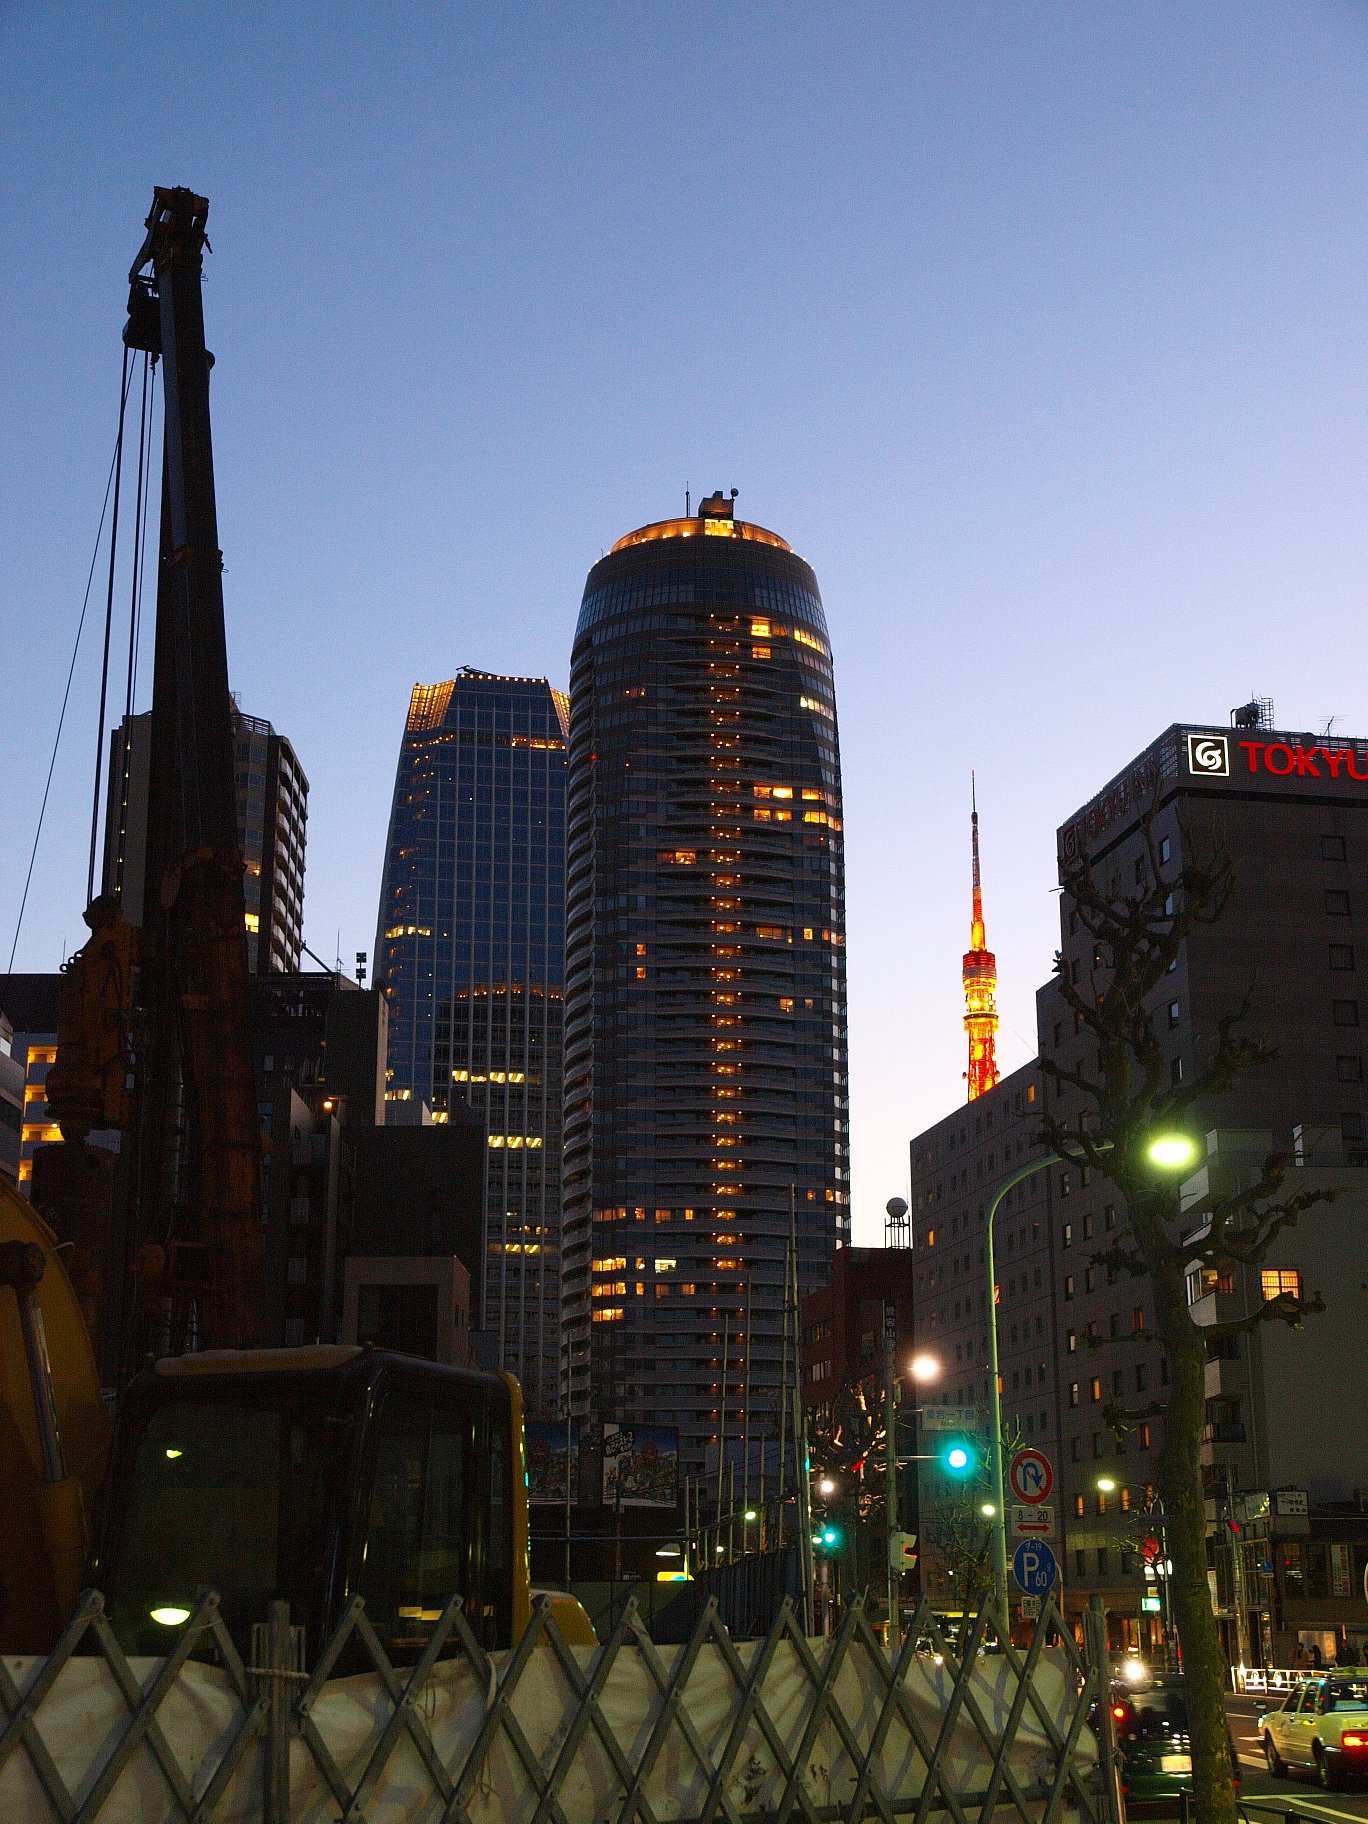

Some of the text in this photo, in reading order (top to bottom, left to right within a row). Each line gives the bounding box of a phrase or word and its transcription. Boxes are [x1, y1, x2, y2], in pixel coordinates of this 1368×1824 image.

[1239, 741, 1368, 781] TOKYU
[1037, 1510, 1049, 1521] 20
[1023, 1552, 1040, 1587] P
[1035, 1571, 1047, 1587] 60
